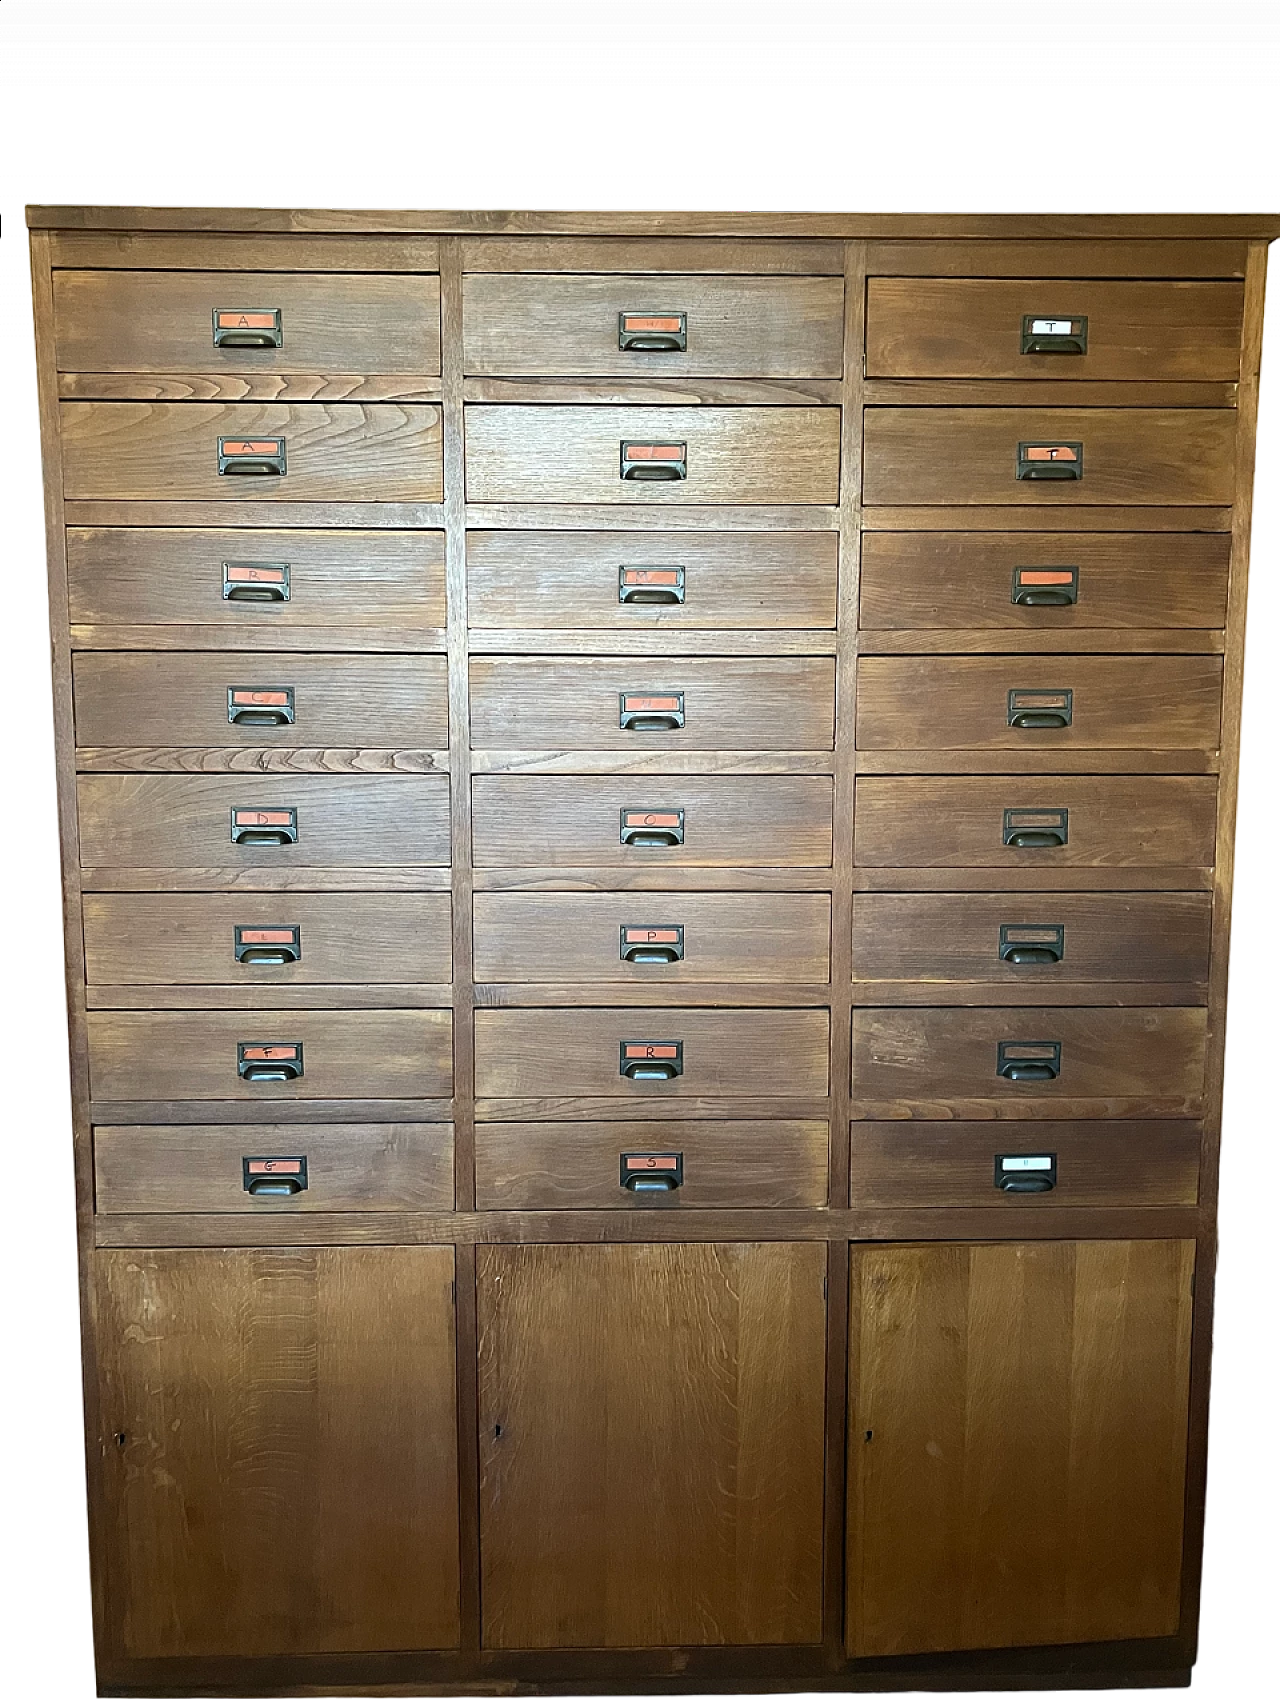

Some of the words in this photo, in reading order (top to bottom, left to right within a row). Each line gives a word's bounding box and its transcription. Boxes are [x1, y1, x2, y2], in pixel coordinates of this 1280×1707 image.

[239, 316, 249, 327] A
[1045, 322, 1056, 332] T
[242, 441, 254, 451] A
[1046, 449, 1059, 461] T
[251, 692, 264, 702] C
[257, 813, 268, 825] D
[644, 814, 656, 825] O
[647, 931, 656, 942] P
[262, 1046, 272, 1058] F
[646, 1046, 654, 1058] R
[264, 1160, 276, 1171] G
[646, 1157, 656, 1168] S
